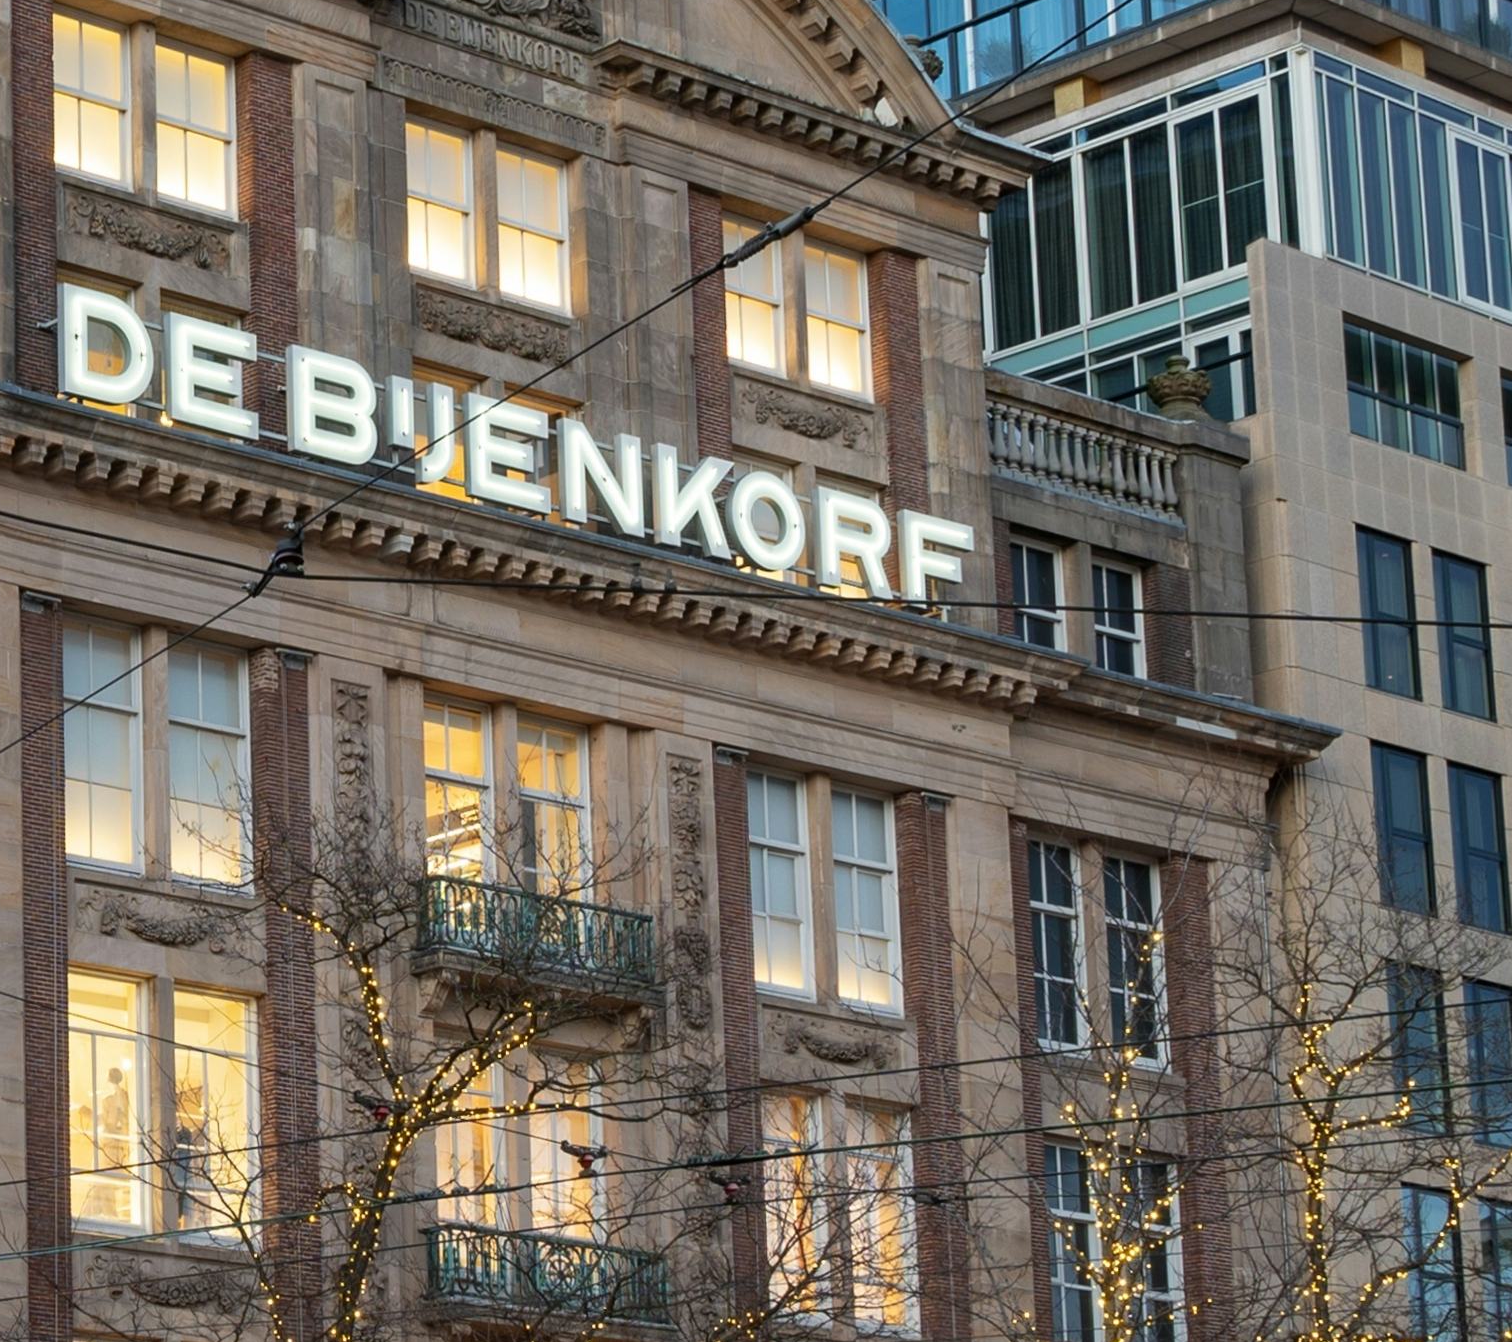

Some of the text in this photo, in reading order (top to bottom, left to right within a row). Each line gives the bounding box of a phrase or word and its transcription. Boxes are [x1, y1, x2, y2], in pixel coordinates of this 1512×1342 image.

[444, 13, 588, 86] BIJENKORF
[58, 282, 975, 609] DE BIJENKORF
